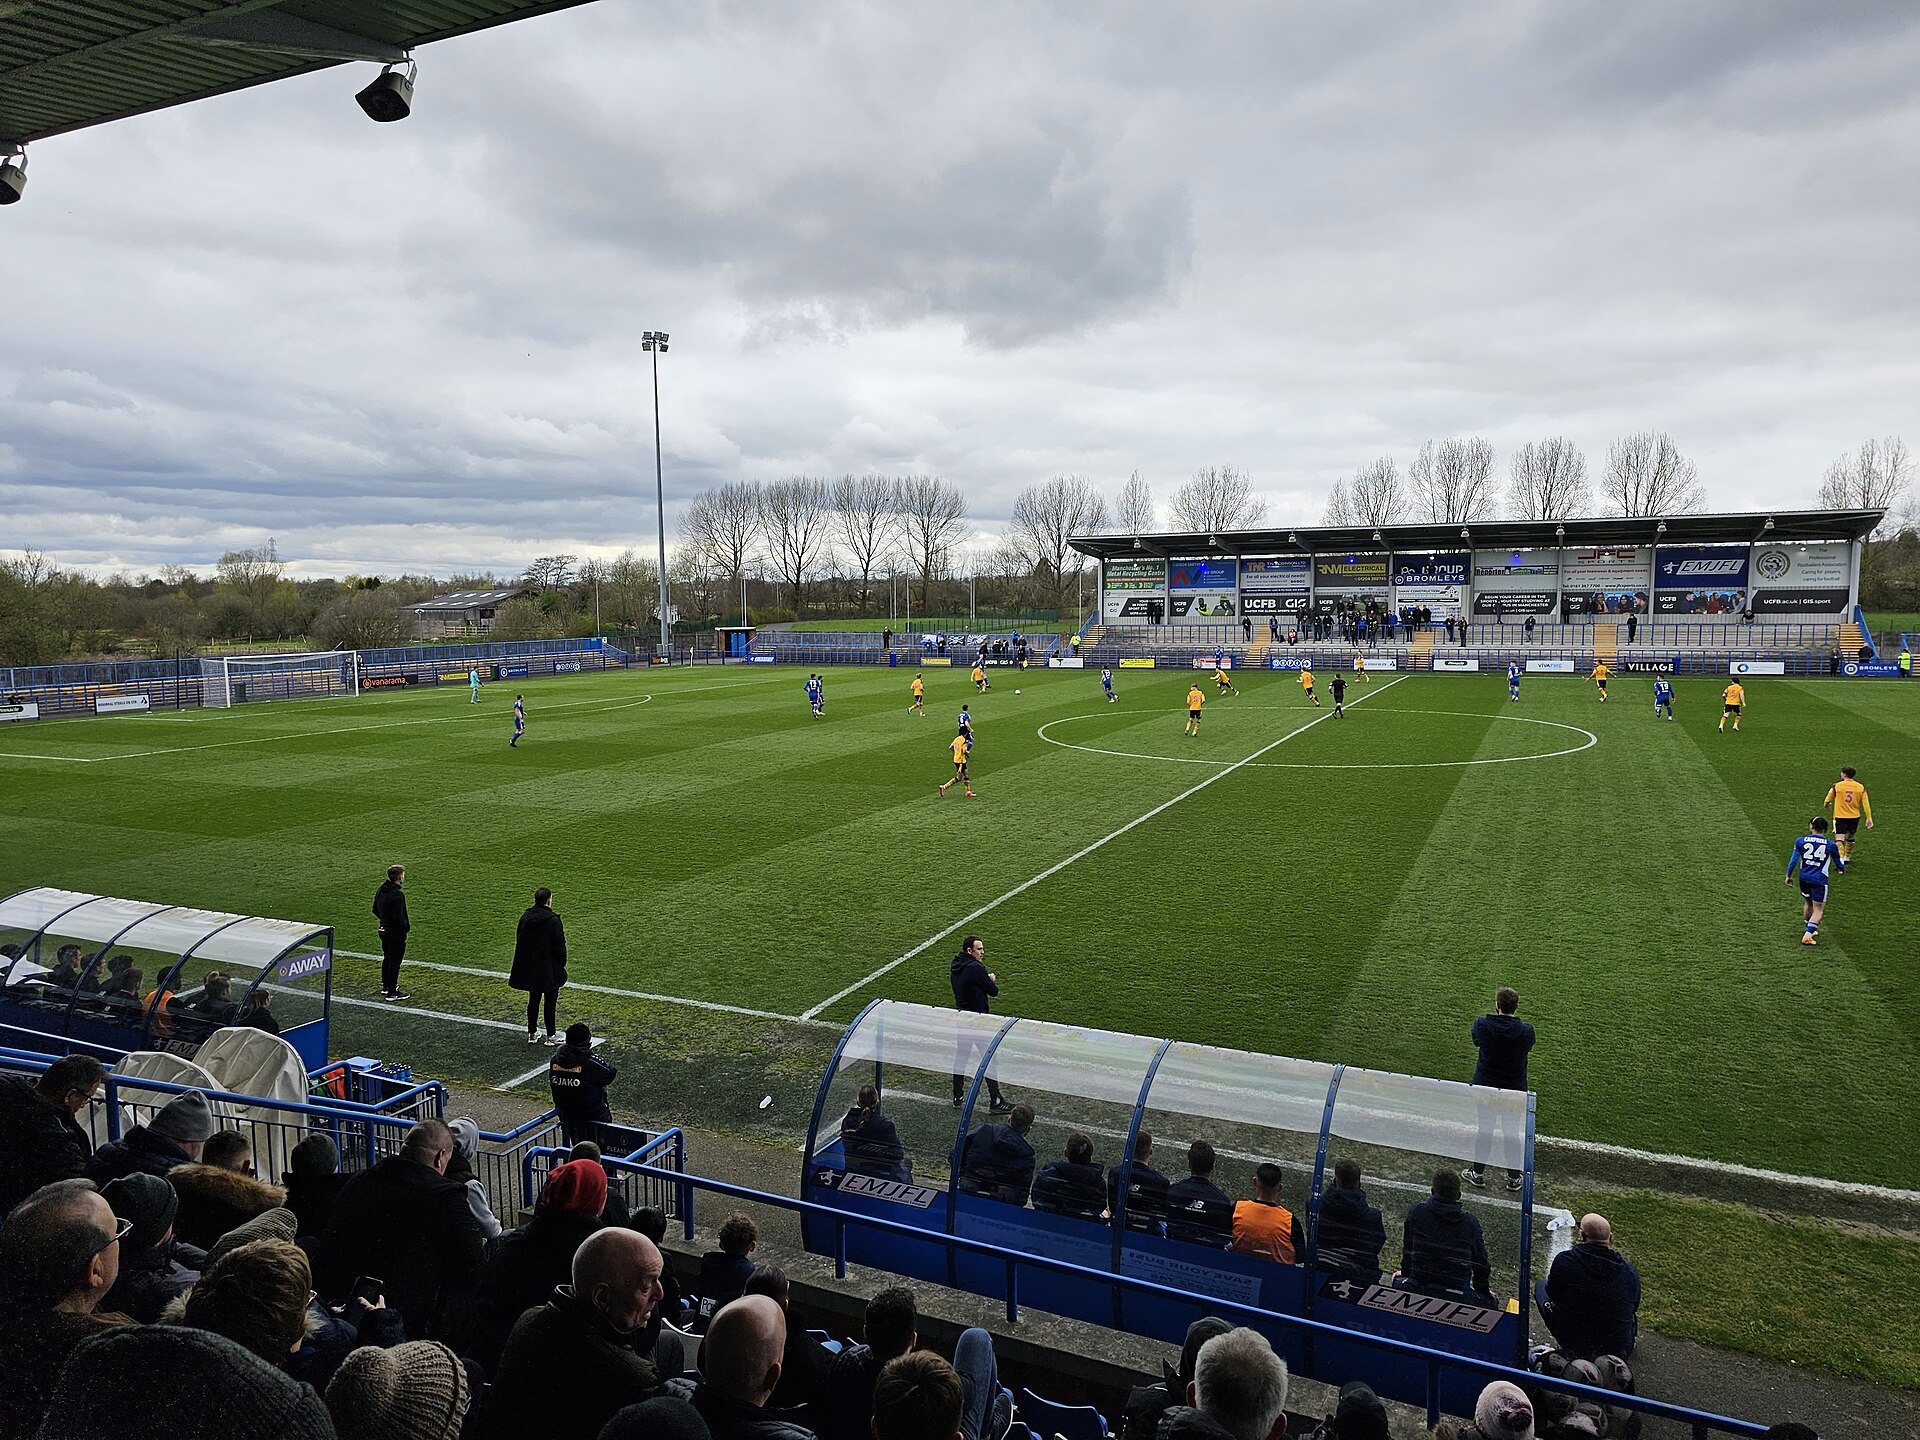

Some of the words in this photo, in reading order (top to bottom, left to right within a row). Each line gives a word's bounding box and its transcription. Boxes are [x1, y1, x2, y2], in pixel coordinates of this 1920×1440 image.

[1246, 562, 1266, 571] TNR
[1681, 561, 1738, 572] EMJFL
[1406, 574, 1465, 582] BROMLEYS
[1245, 599, 1277, 609] UCFB
[1285, 599, 1307, 608] GIS
[1628, 662, 1675, 672] VILLAGE
[371, 676, 407, 688] vanarama
[1660, 682, 1670, 692] 19
[1845, 790, 1854, 804] 3
[1803, 843, 1827, 861] 24
[288, 953, 327, 977] AWAY
[167, 1040, 201, 1055] EMJ
[558, 1077, 581, 1087] JAKO
[606, 1145, 628, 1155] PLEASE
[844, 1174, 928, 1204] EMJFL
[1367, 1287, 1489, 1328] EMJFL
[1377, 1304, 1413, 1316] Manchester
[1414, 1312, 1435, 1321] Junior
[1435, 1315, 1463, 1327] Football
[1463, 1322, 1489, 1332] League
